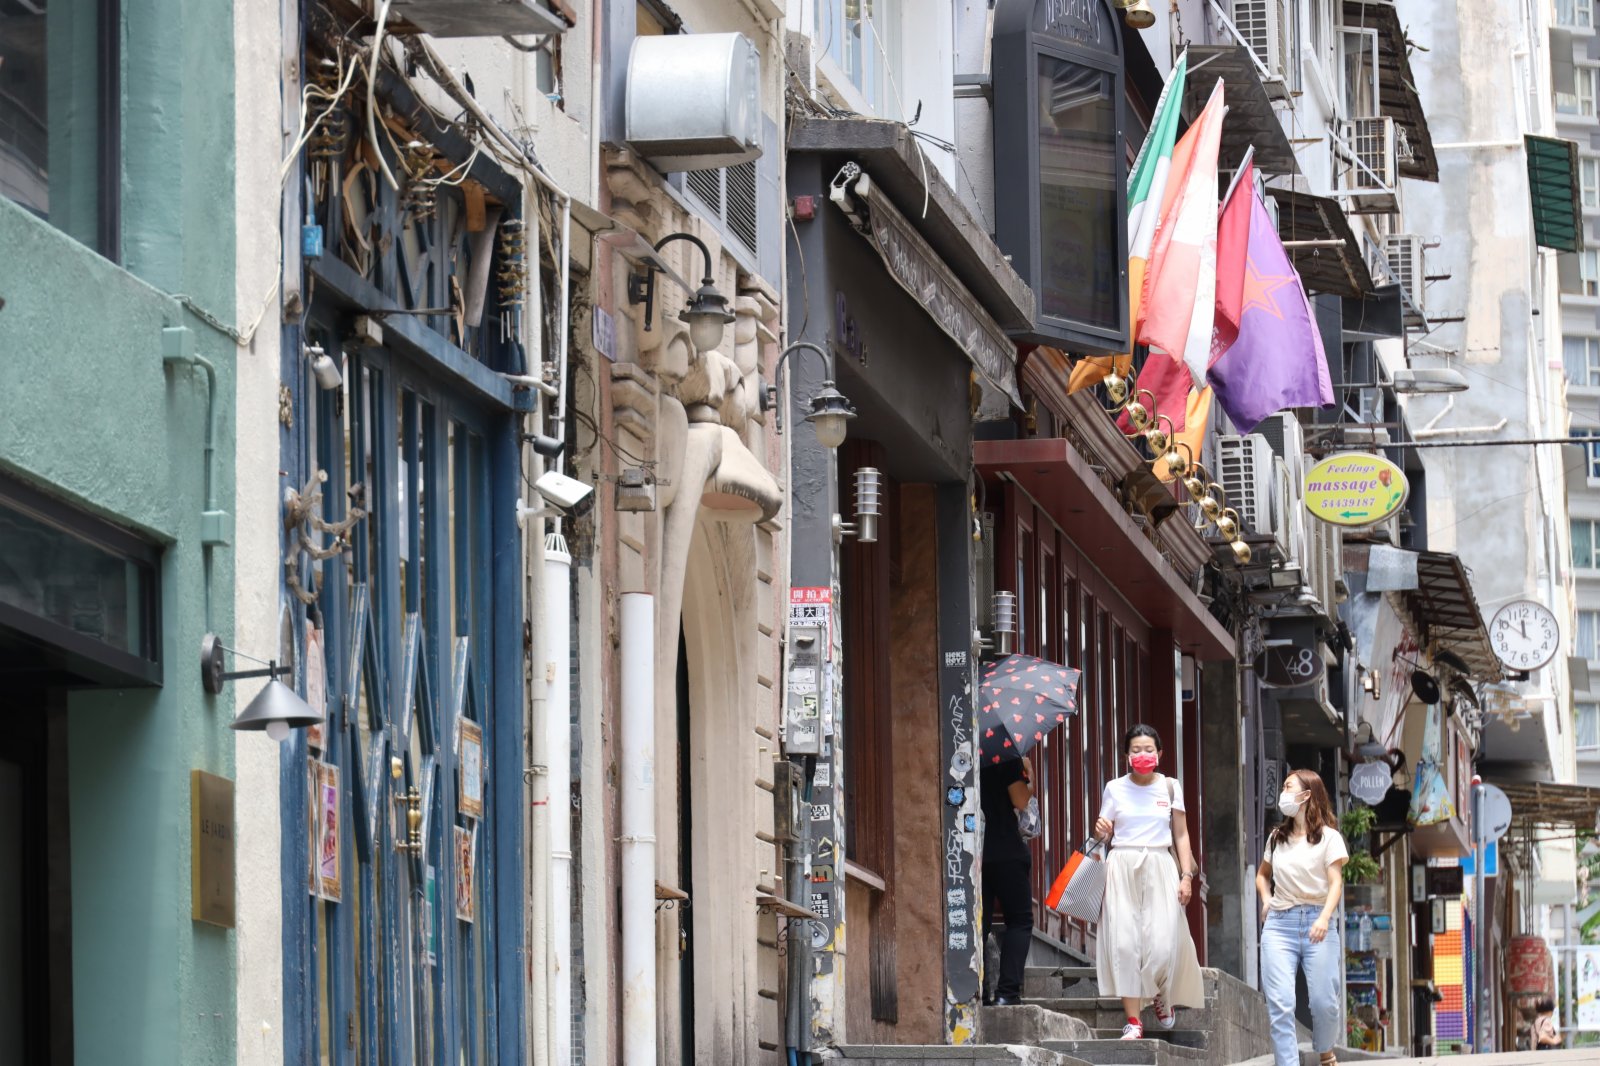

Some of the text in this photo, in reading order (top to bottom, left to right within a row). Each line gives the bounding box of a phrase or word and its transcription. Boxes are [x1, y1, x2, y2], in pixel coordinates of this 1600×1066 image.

[1327, 463, 1376, 474] Feelings
[1308, 479, 1377, 493] massage
[1321, 498, 1376, 509] 54439187
[1519, 607, 1529, 618] 12
[1540, 617, 1548, 628] 2
[1496, 631, 1504, 642] 9
[1544, 629, 1552, 640] 3
[1501, 641, 1509, 652] 8
[1540, 641, 1548, 651] 4
[1510, 650, 1517, 661] 7
[1520, 652, 1529, 664] 6
[1532, 649, 1540, 660] 5
[1286, 649, 1313, 676] 48
[1360, 775, 1385, 789] POLLEN
